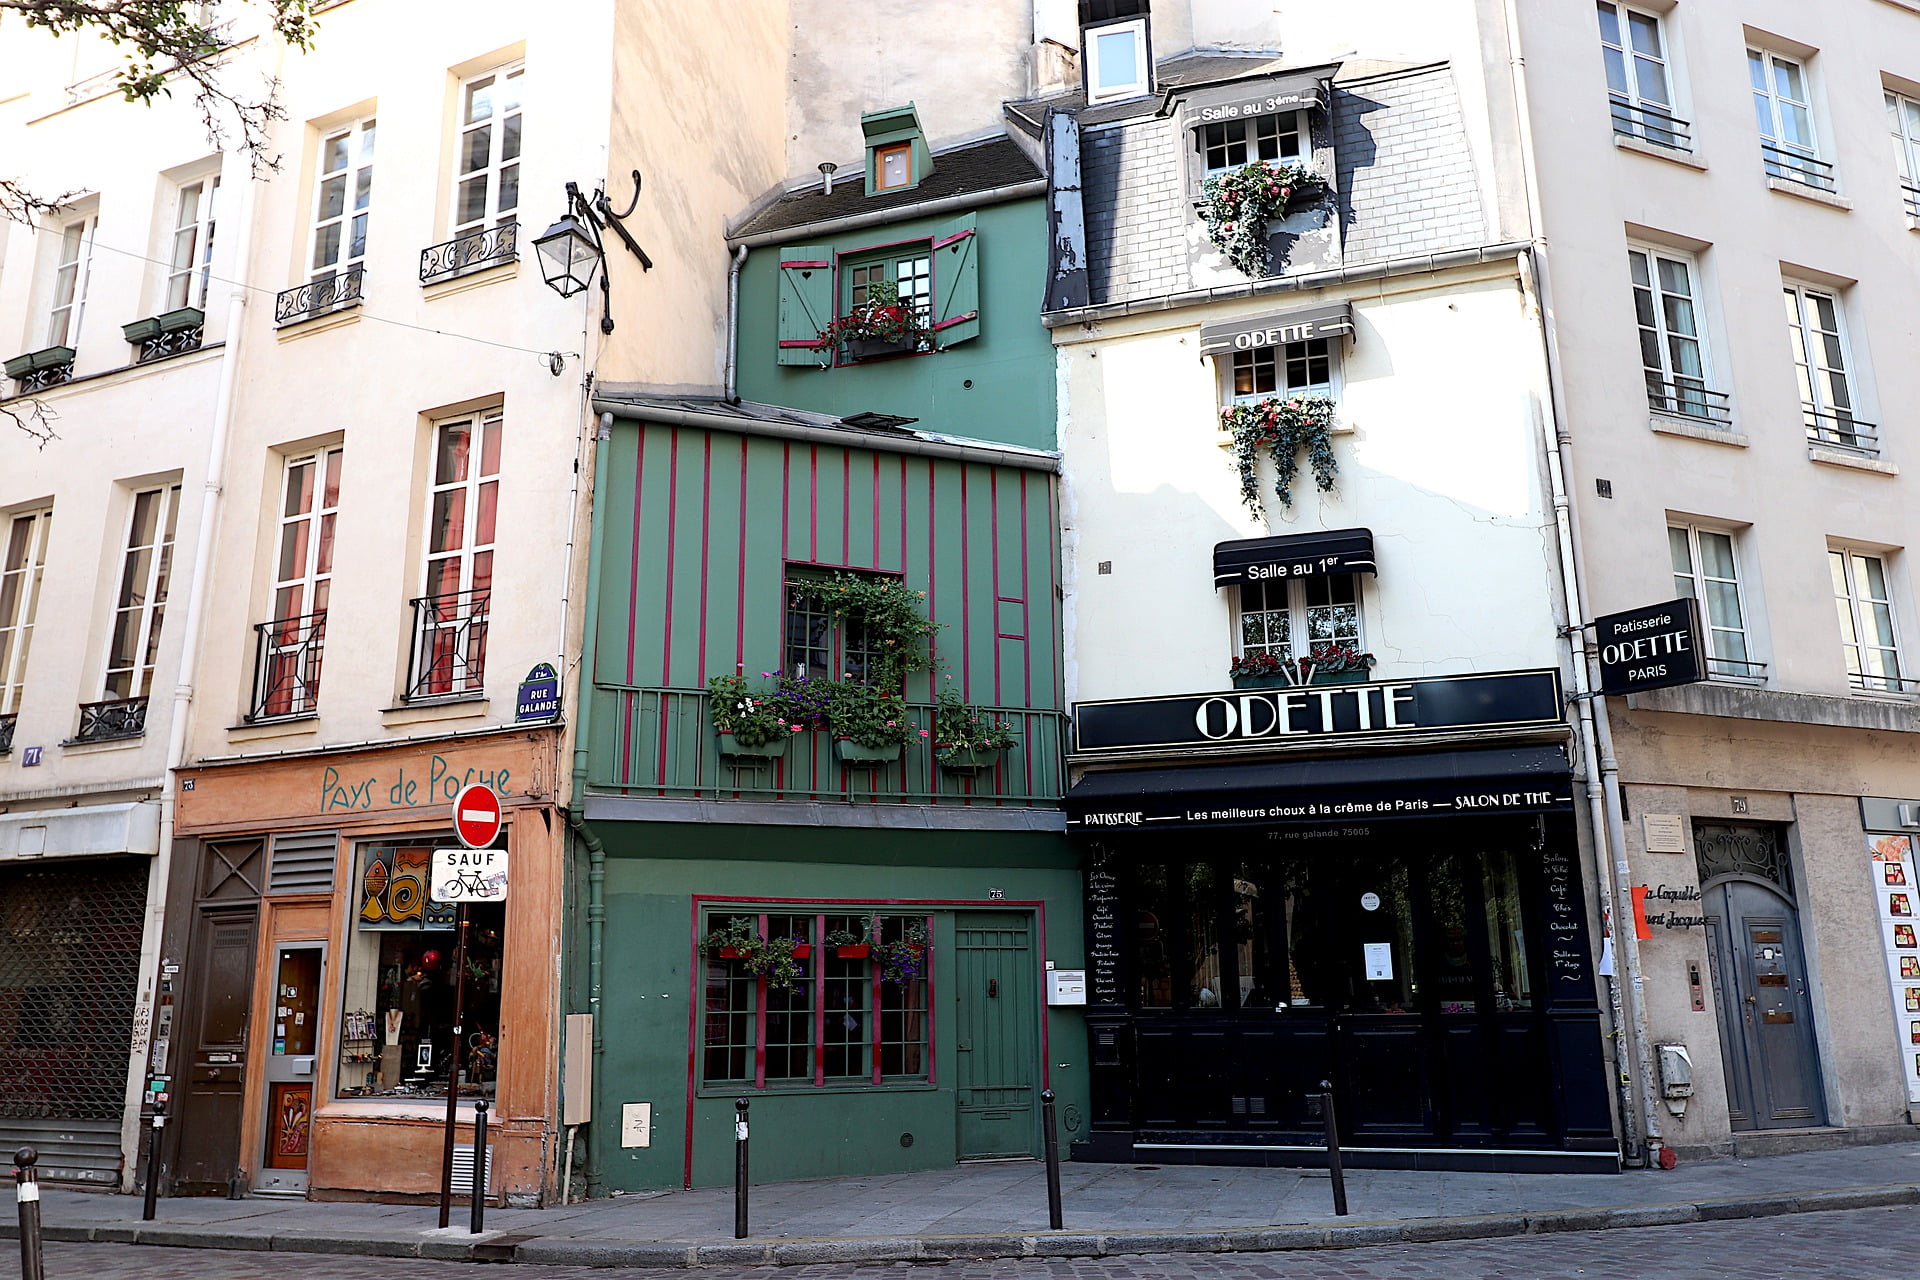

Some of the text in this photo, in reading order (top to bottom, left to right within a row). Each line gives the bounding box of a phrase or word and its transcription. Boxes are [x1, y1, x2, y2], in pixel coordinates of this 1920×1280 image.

[1201, 105, 1239, 122] Salle
[1242, 102, 1262, 115] au
[1234, 323, 1314, 350] ODETTE
[1248, 556, 1339, 580] Salle au 1er
[1613, 613, 1672, 636] Patisserie
[1602, 629, 1690, 666] ODETTE
[1628, 664, 1668, 682] PARIS
[530, 688, 549, 701] RUE
[519, 700, 558, 714] GALANDE
[1195, 684, 1417, 740] ODETTE
[25, 748, 39, 765] 71
[390, 768, 418, 806] de
[1455, 791, 1551, 810] SALON DE THE
[1733, 799, 1747, 813] 79
[1084, 811, 1144, 826] PATISSERIE
[1186, 810, 1208, 821] Les
[1211, 808, 1266, 820] meilleurs
[1269, 805, 1306, 817] choux
[1308, 804, 1317, 815] à
[1319, 804, 1331, 814] la
[1376, 800, 1392, 812] de
[1395, 799, 1429, 811] Paris
[1267, 827, 1370, 840] 77, rue galande 75005
[447, 853, 495, 866] SAUF
[990, 890, 1003, 898] 75
[1550, 883, 1568, 897] Café
[1550, 922, 1579, 931] Chocolat
